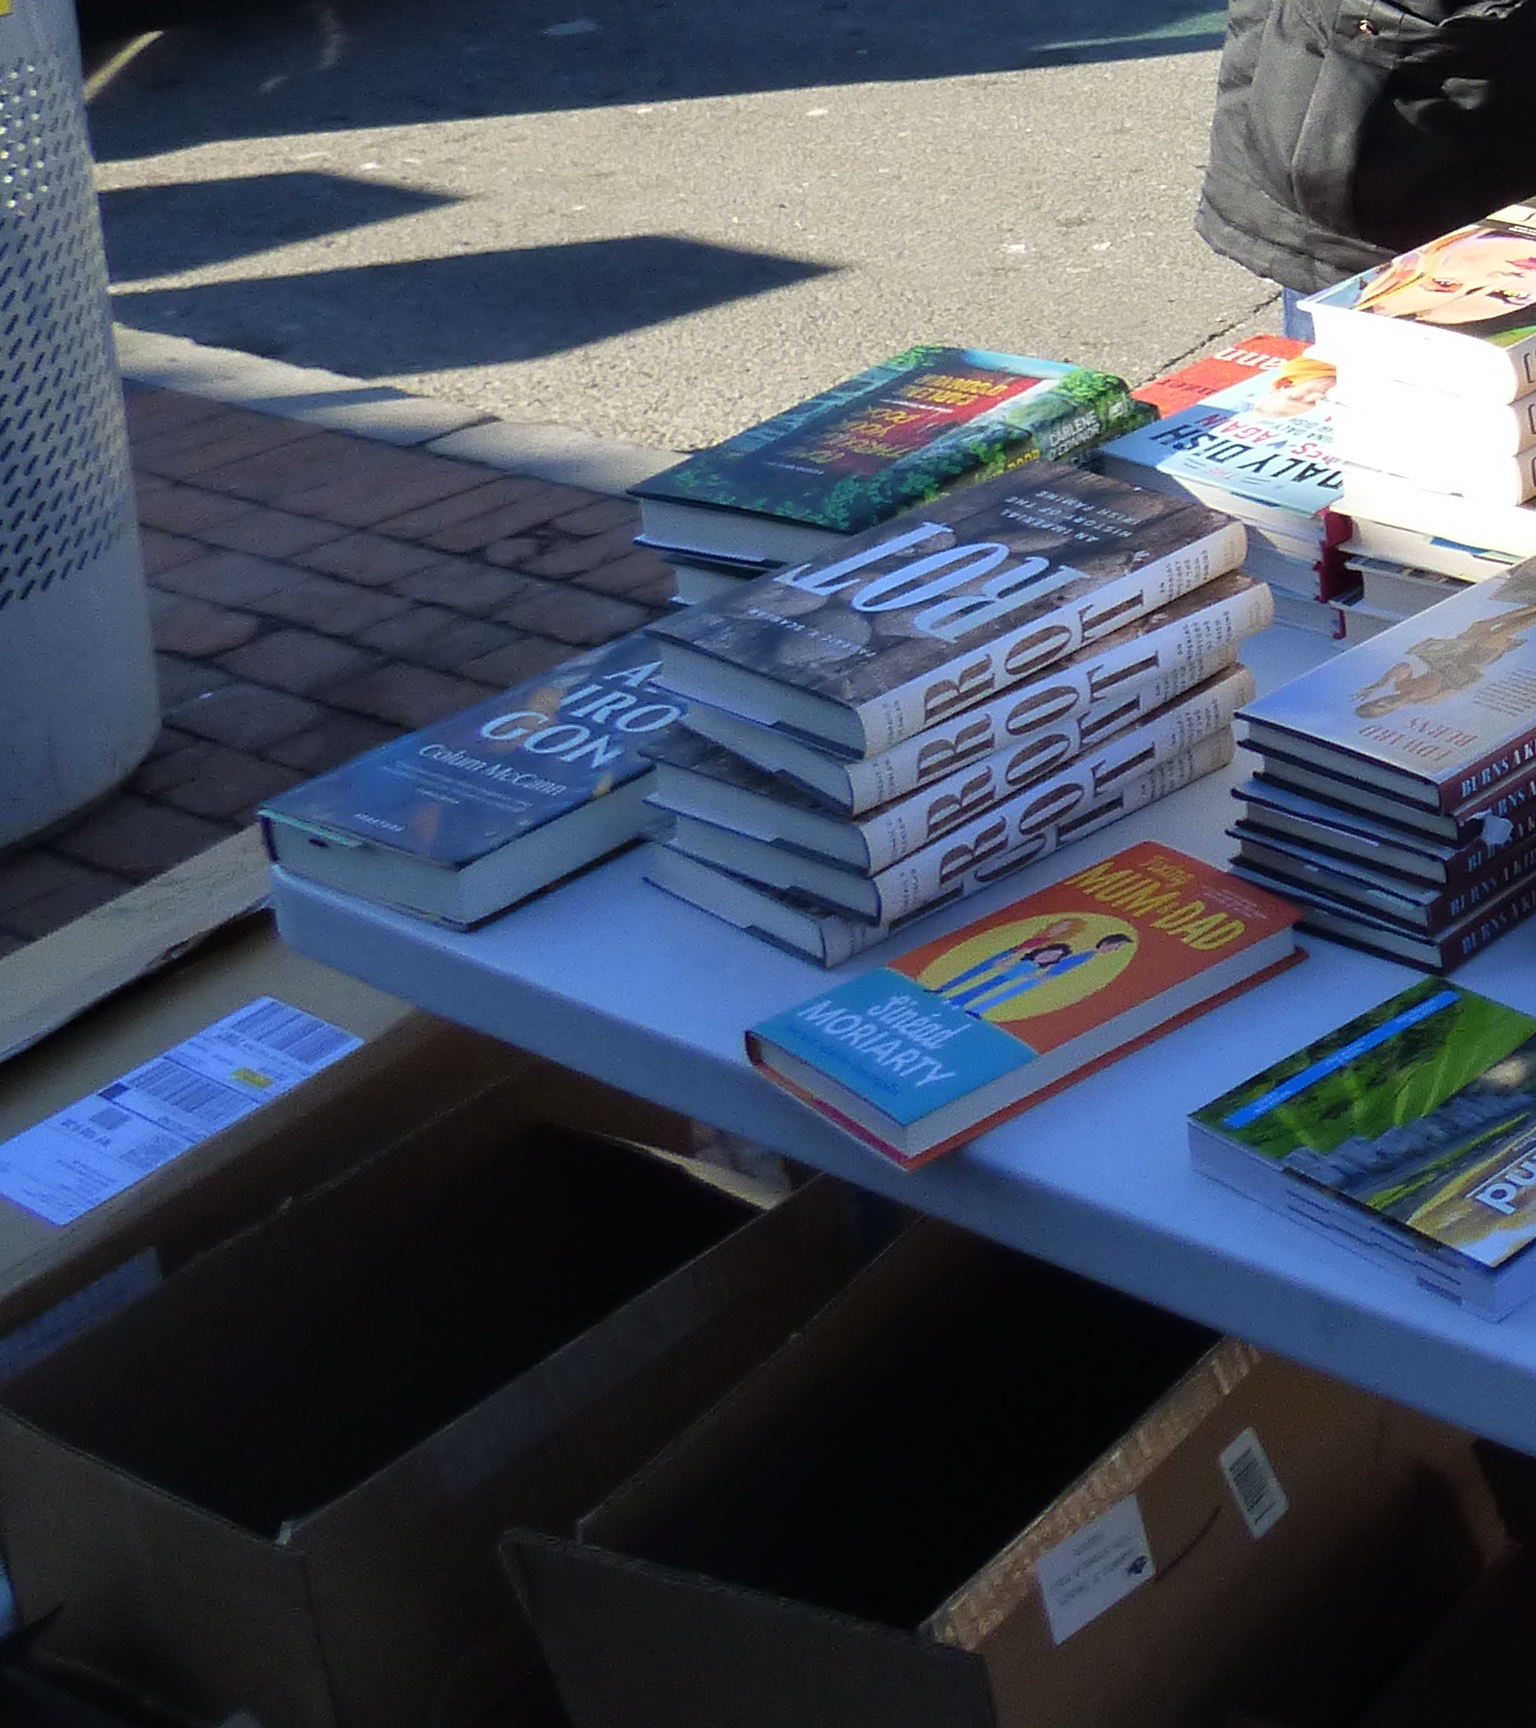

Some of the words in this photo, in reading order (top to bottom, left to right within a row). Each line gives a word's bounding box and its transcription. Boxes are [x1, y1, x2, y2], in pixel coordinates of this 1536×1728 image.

[1048, 409, 1098, 445] CARLENE
[1149, 424, 1254, 464] DISH
[1200, 412, 1279, 446] AGAIN
[1004, 495, 1034, 510] THE
[1072, 512, 1133, 539] HISTORY
[922, 588, 1146, 725] ROT
[917, 648, 1161, 784] ROT
[480, 710, 627, 769] GON
[418, 743, 489, 771] Colum
[482, 764, 567, 798] McCann
[1460, 753, 1510, 798] BURNS
[796, 998, 956, 1088] MORIARTY
